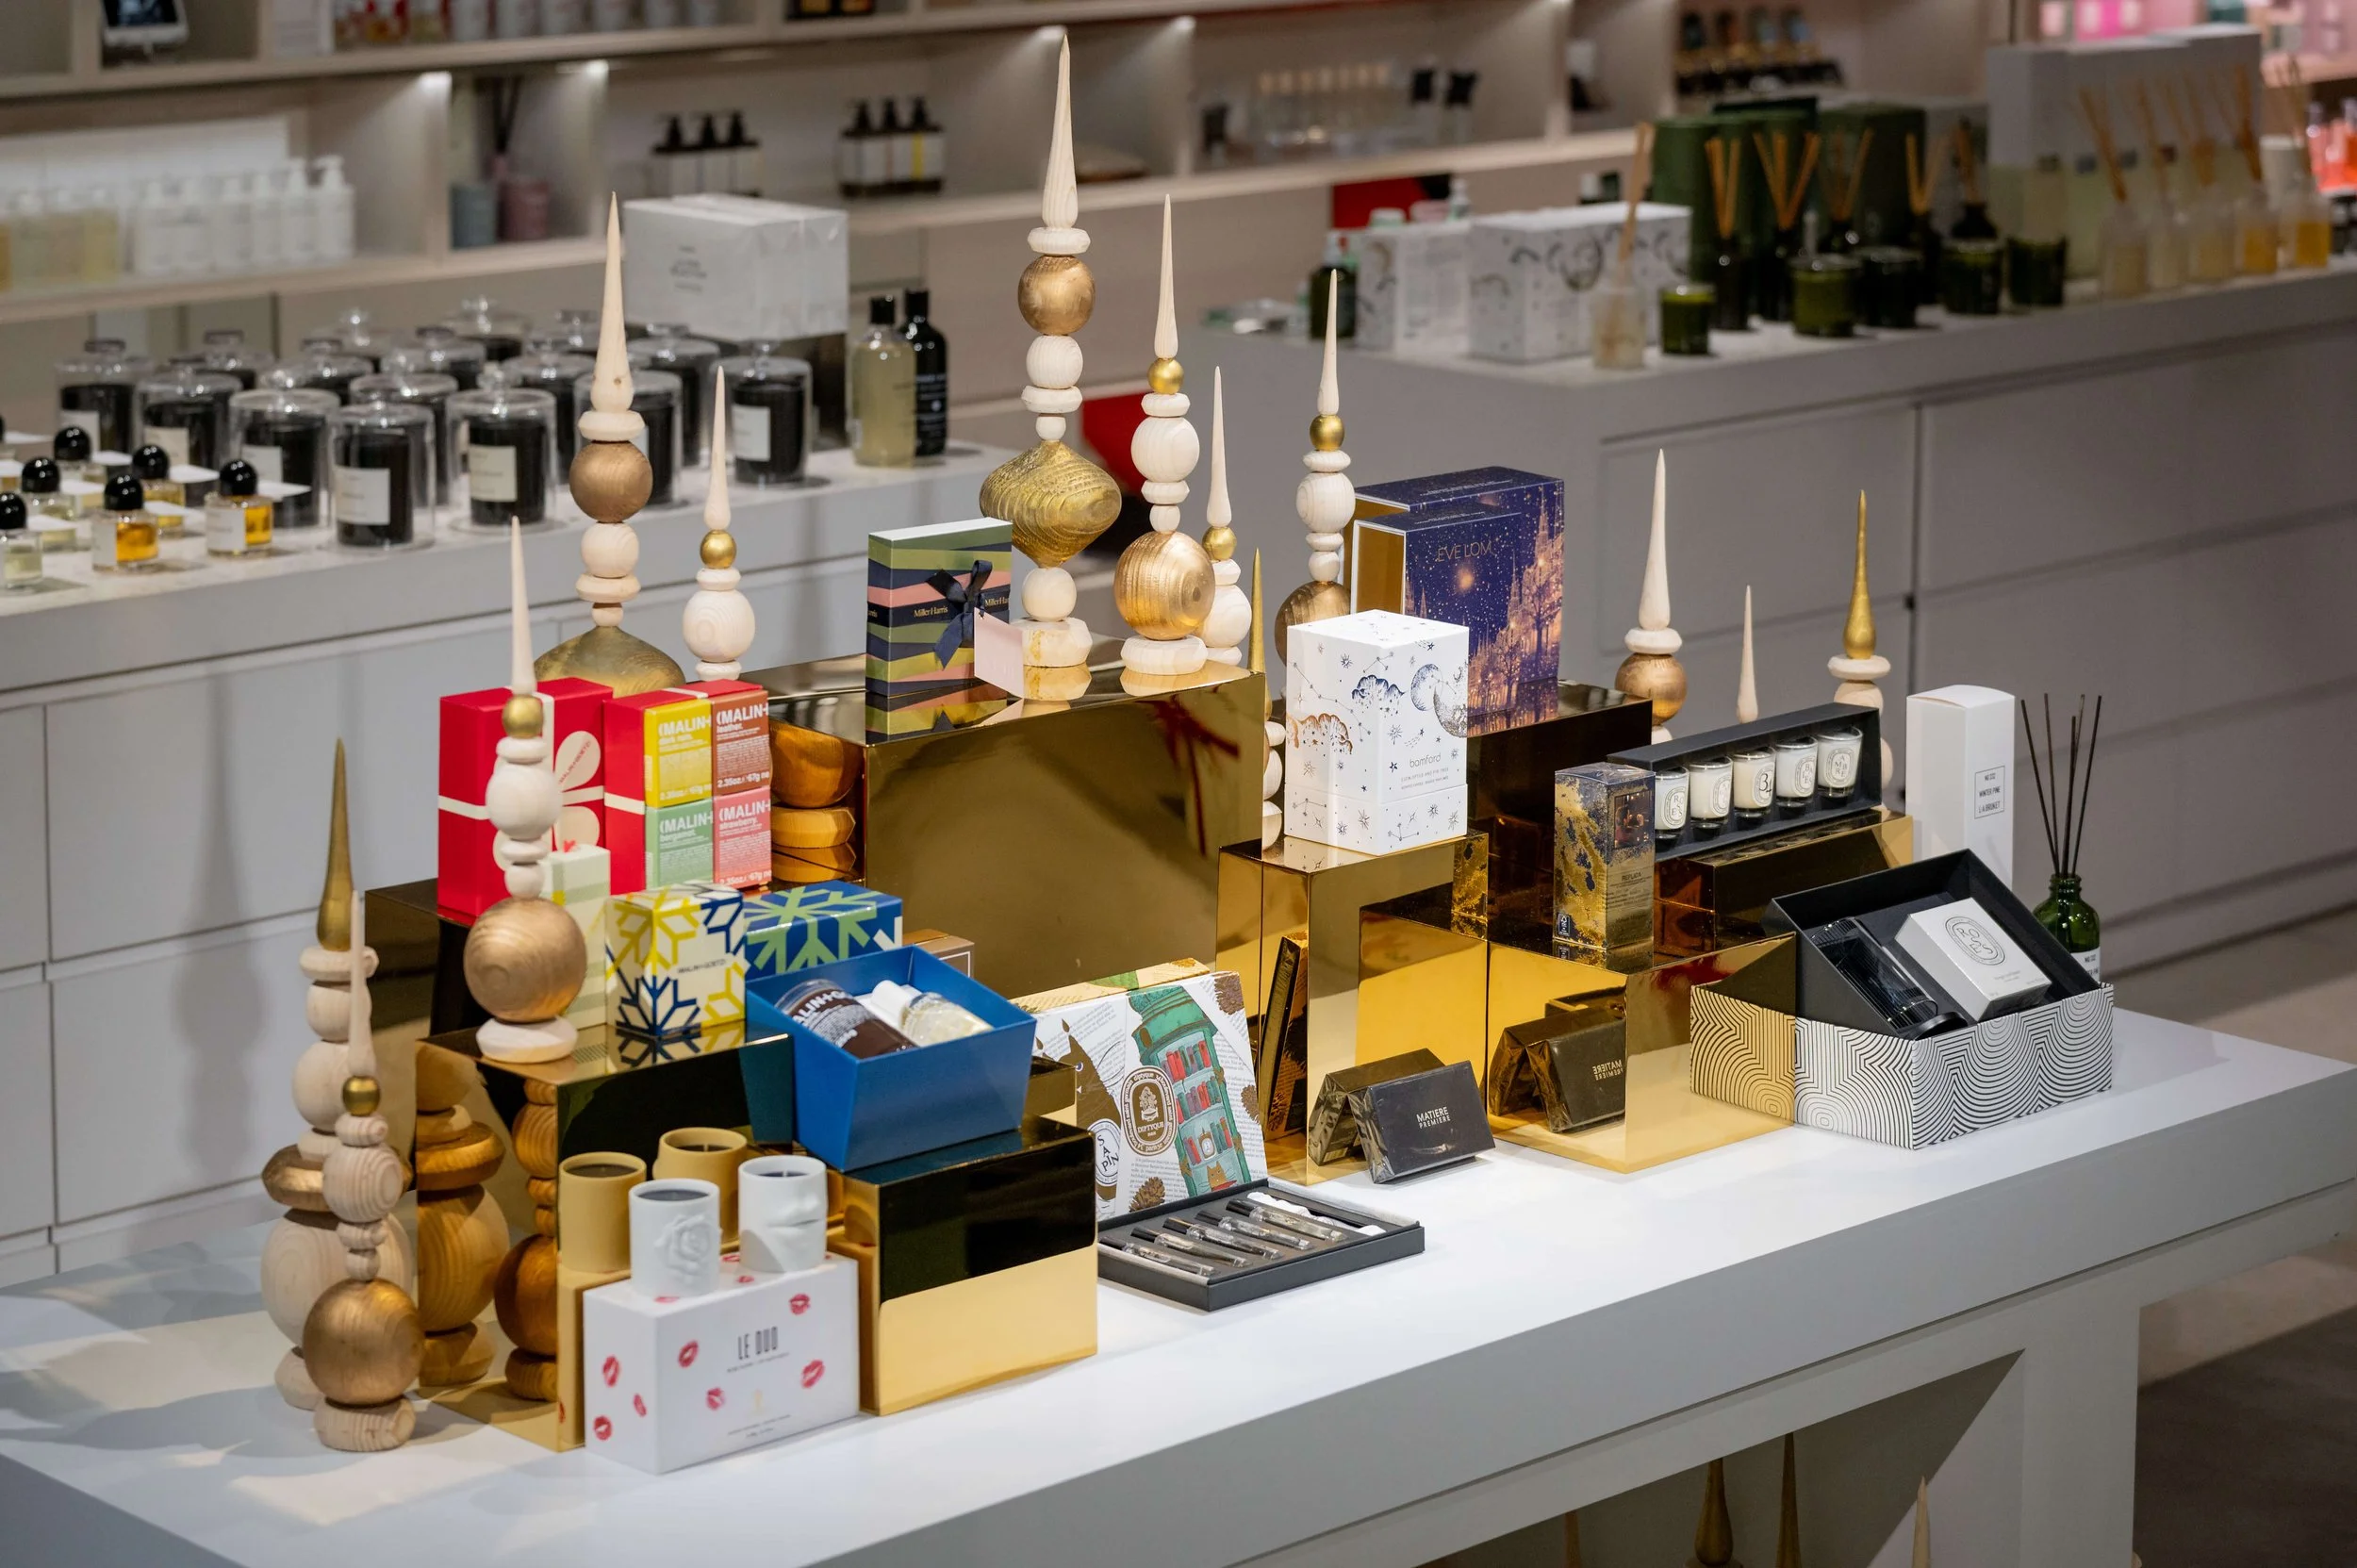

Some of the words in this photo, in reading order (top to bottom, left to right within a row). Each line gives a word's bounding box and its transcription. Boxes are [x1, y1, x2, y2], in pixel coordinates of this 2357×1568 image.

[1437, 545, 1461, 562] EVE
[1409, 752, 1442, 767] bamford
[1416, 1106, 1449, 1123] MATIERE
[1419, 1114, 1451, 1130] PREMIERE
[1137, 1121, 1164, 1133] DIPTYQUE
[737, 1332, 750, 1360] LE
[755, 1326, 779, 1355] DUO
